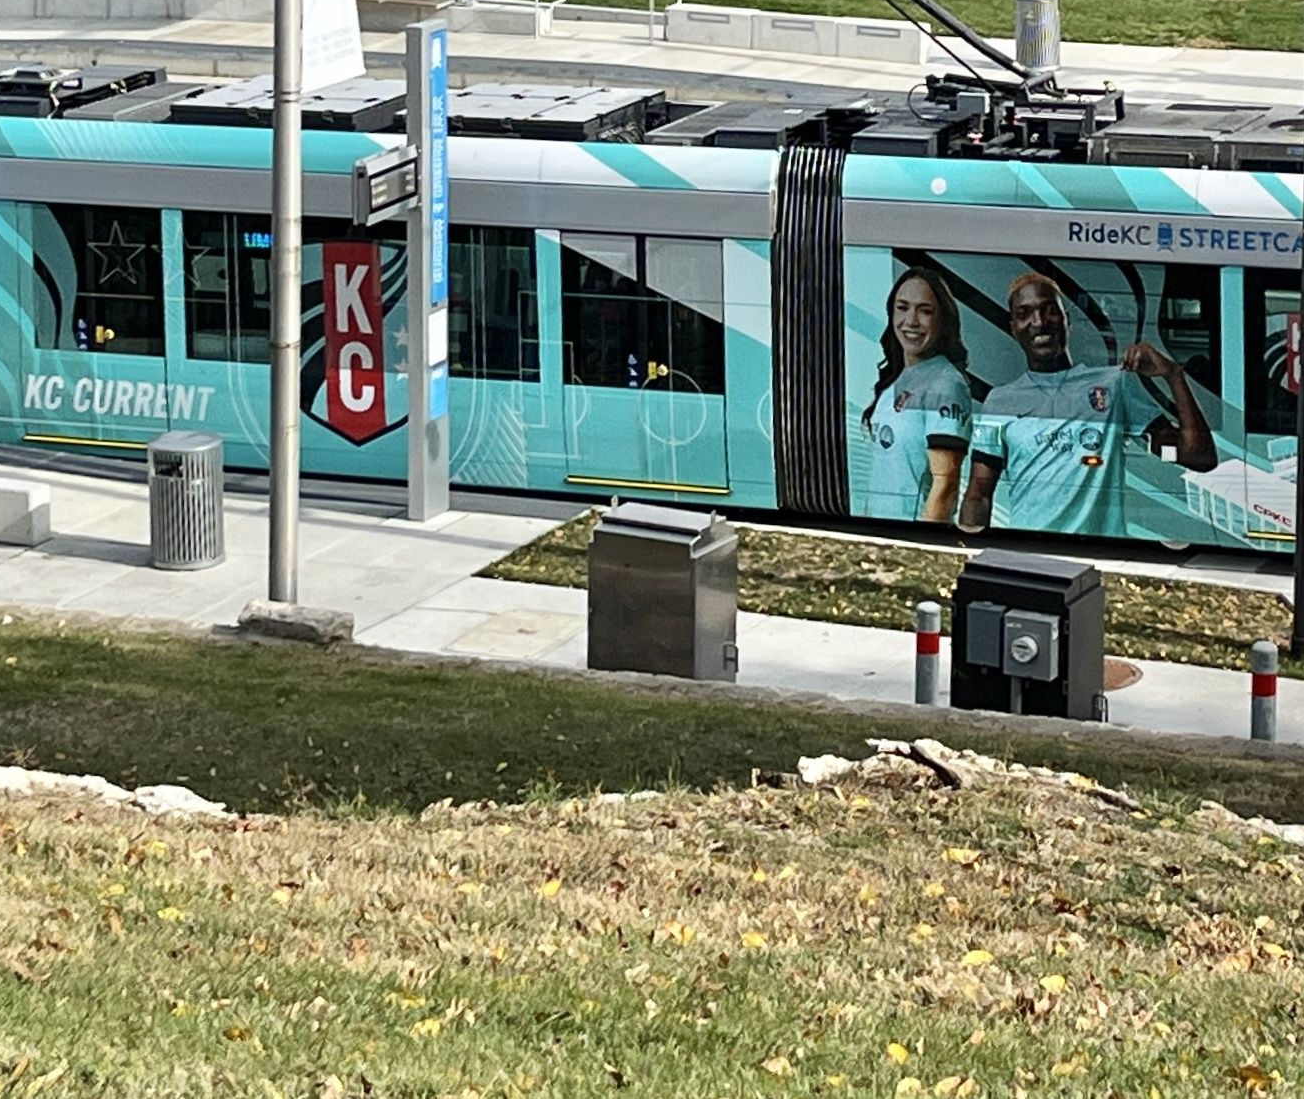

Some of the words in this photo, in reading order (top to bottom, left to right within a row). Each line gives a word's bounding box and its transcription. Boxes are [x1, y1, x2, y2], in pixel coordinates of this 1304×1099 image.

[1068, 221, 1152, 246] RideKC
[1179, 227, 1304, 254] STREETCA
[333, 263, 376, 413] KC
[23, 374, 65, 411] KC
[73, 378, 216, 422] CURRENT
[1253, 504, 1293, 527] CPKC
